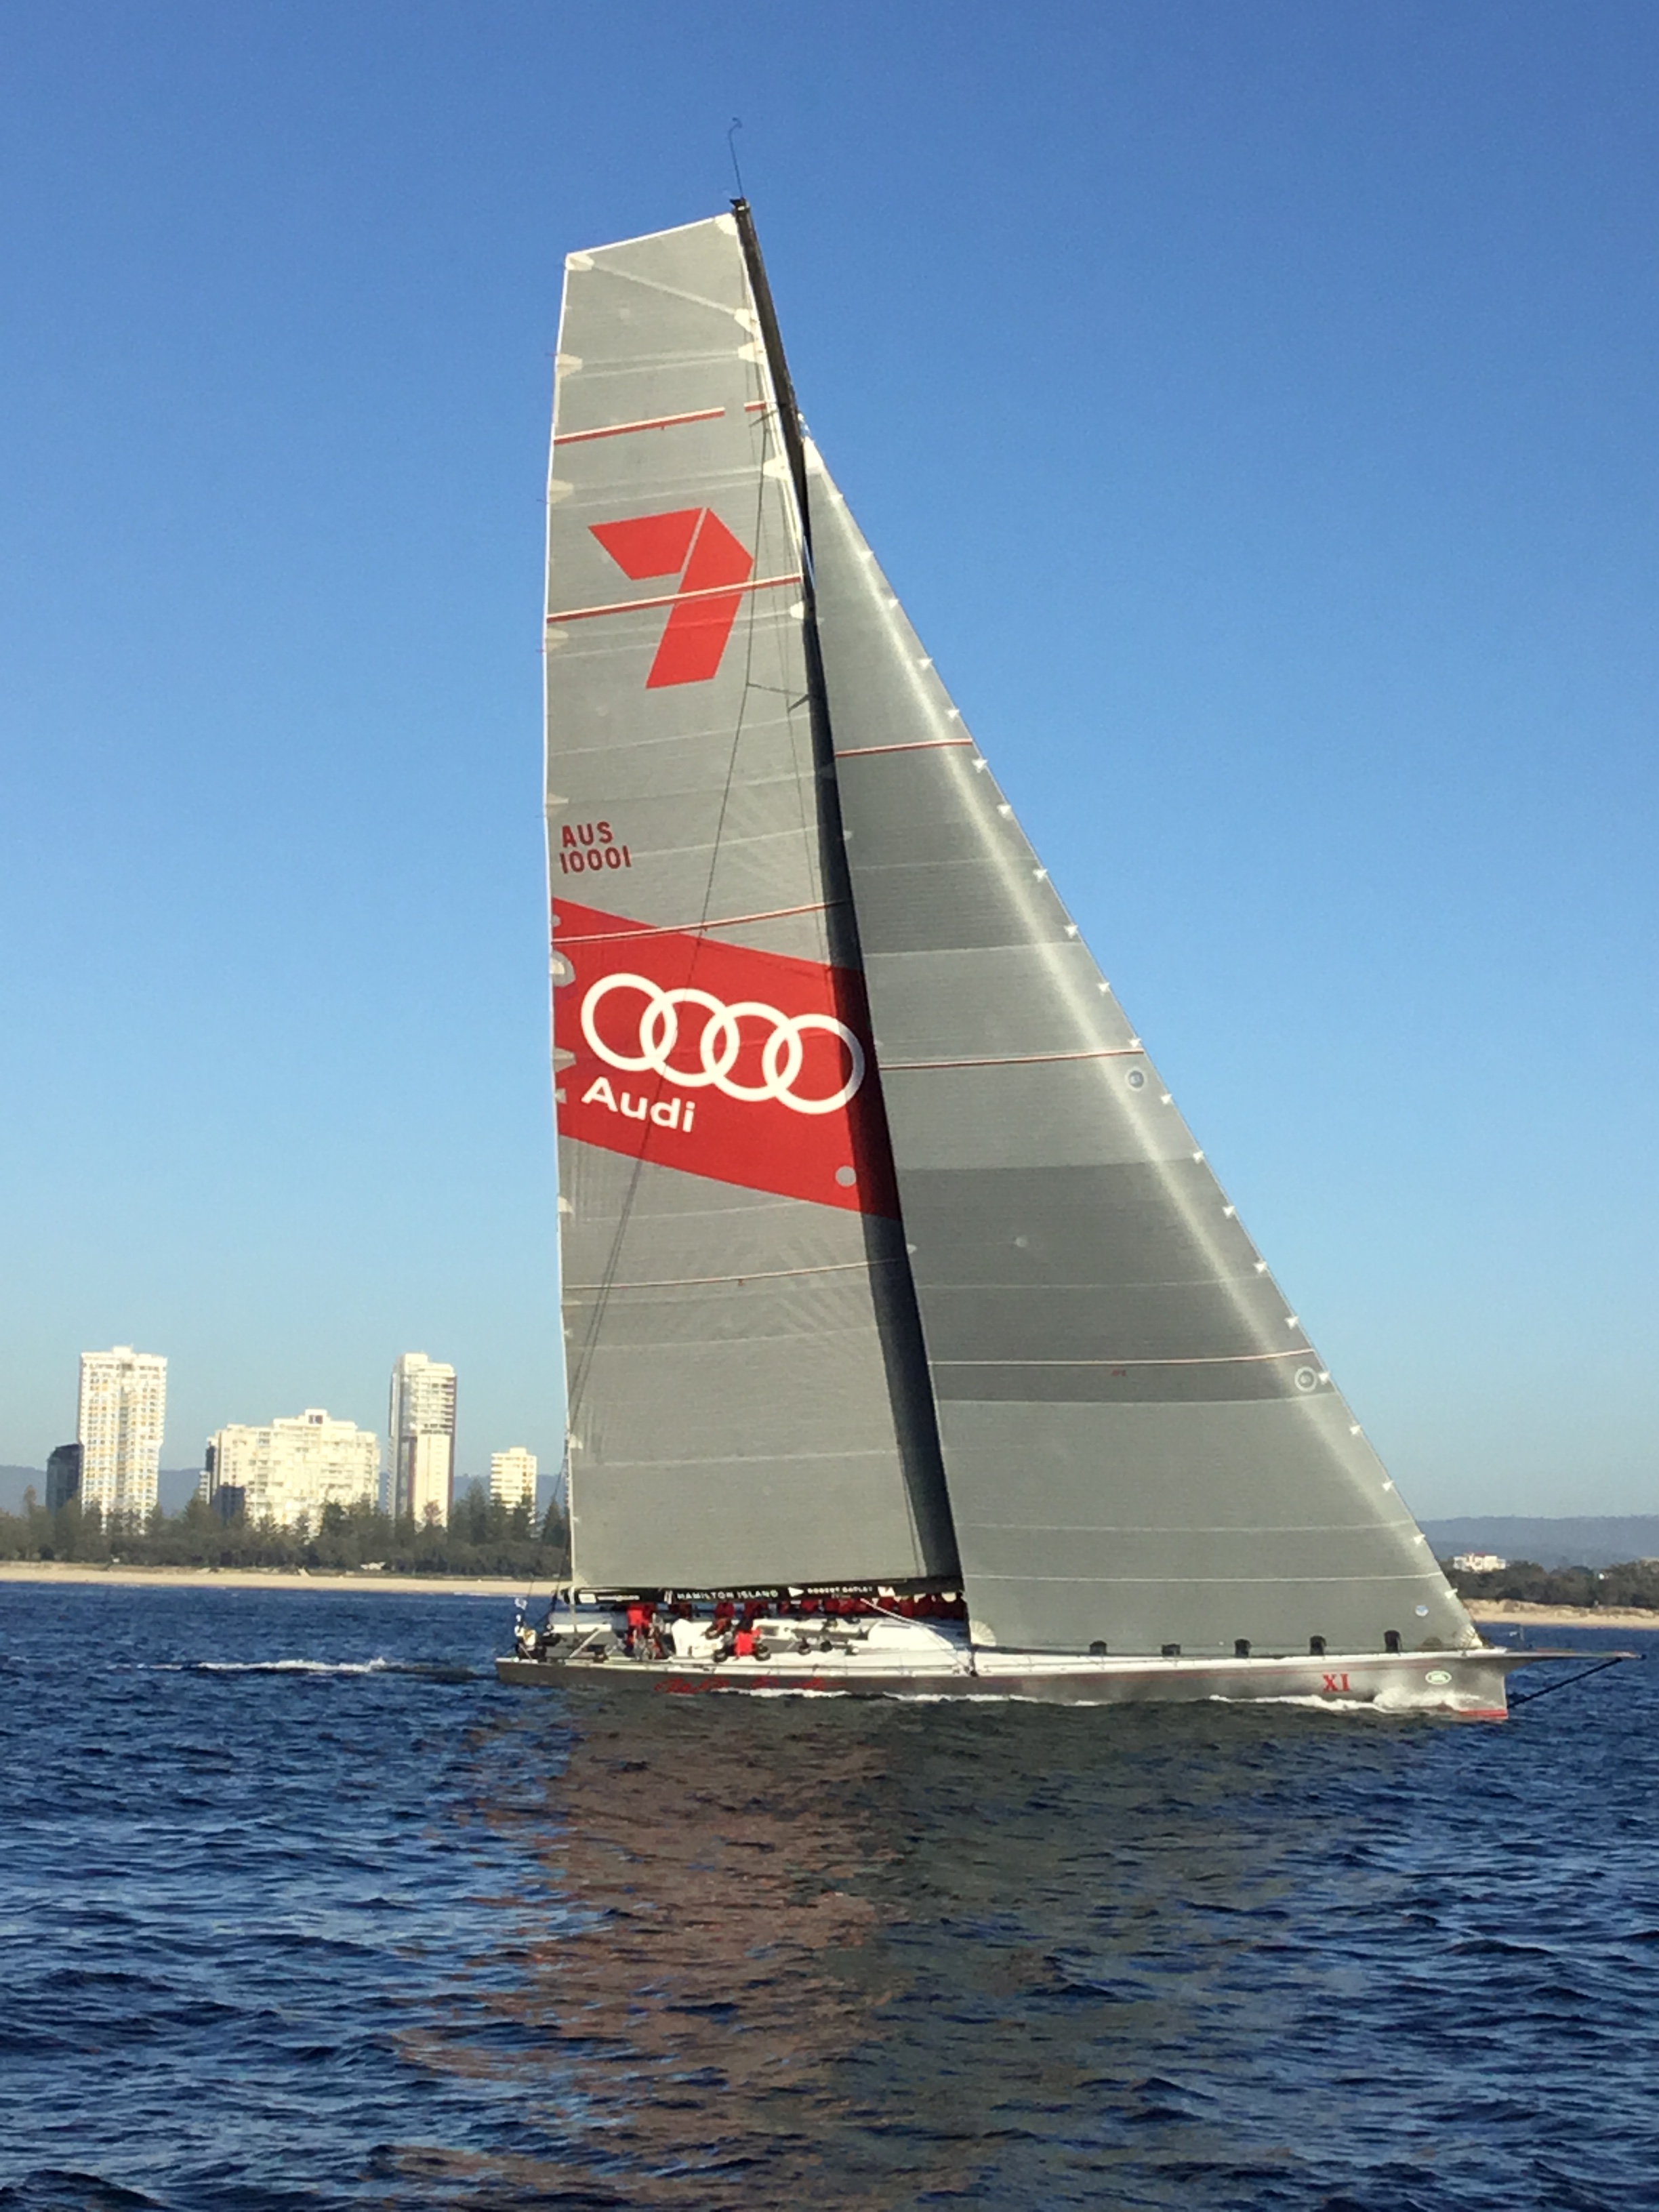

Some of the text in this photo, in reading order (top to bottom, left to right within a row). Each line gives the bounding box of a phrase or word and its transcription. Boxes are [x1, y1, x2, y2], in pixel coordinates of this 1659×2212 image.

[562, 821, 613, 847] AUS
[560, 845, 632, 874] 10001
[581, 1077, 695, 1132] Audi
[1323, 1673, 1350, 1692] XI
